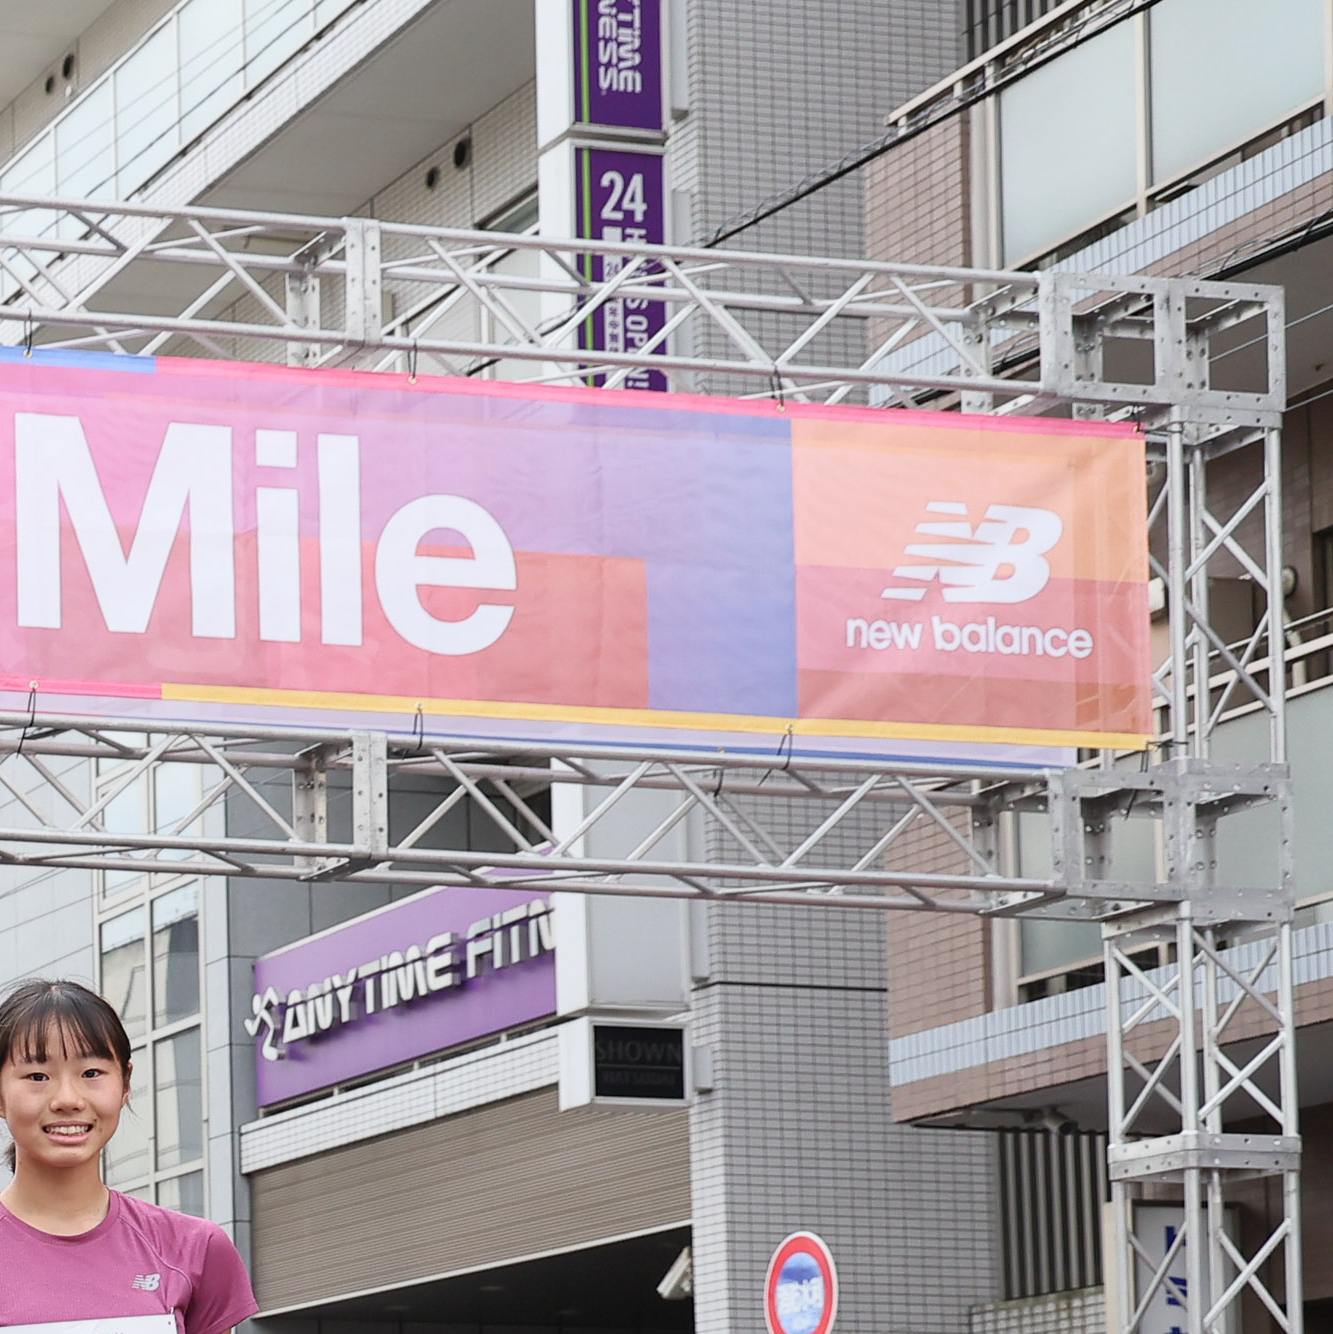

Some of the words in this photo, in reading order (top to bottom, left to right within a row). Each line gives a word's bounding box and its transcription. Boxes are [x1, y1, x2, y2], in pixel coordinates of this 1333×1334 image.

[617, 0, 641, 93] TIME
[600, 170, 647, 223] 24
[14, 410, 517, 657] Mile
[845, 617, 924, 650] new
[931, 616, 1094, 659] balance
[281, 931, 461, 1044] ANYTIME
